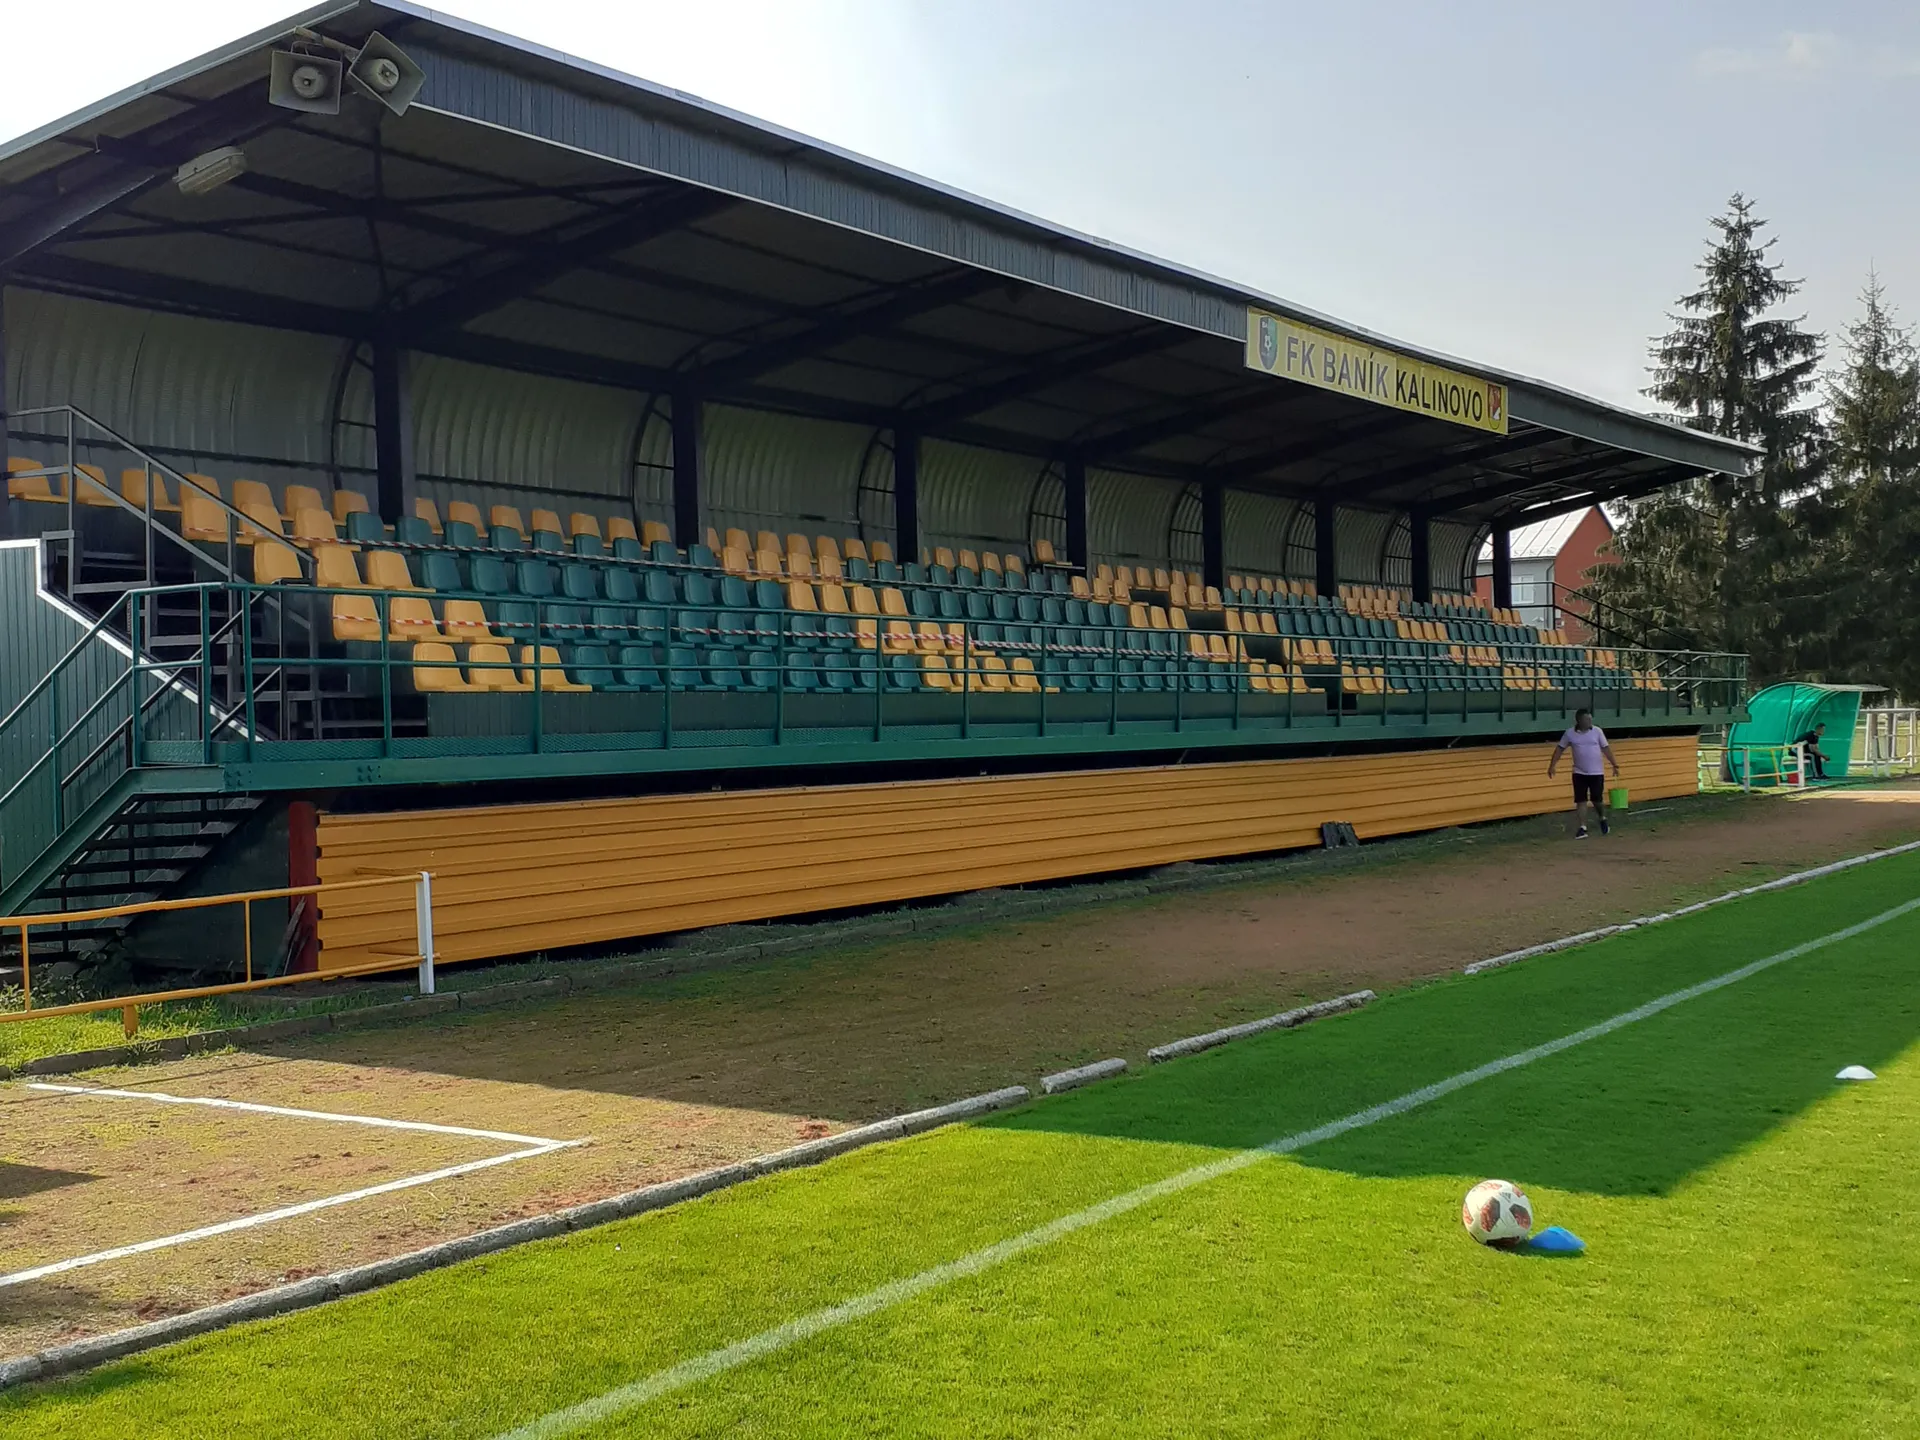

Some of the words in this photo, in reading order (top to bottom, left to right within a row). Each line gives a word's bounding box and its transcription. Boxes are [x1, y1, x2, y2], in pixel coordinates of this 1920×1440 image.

[1286, 336, 1315, 378] FK
[1323, 347, 1388, 398] BANÍK
[1396, 369, 1482, 422] KALINOVO
